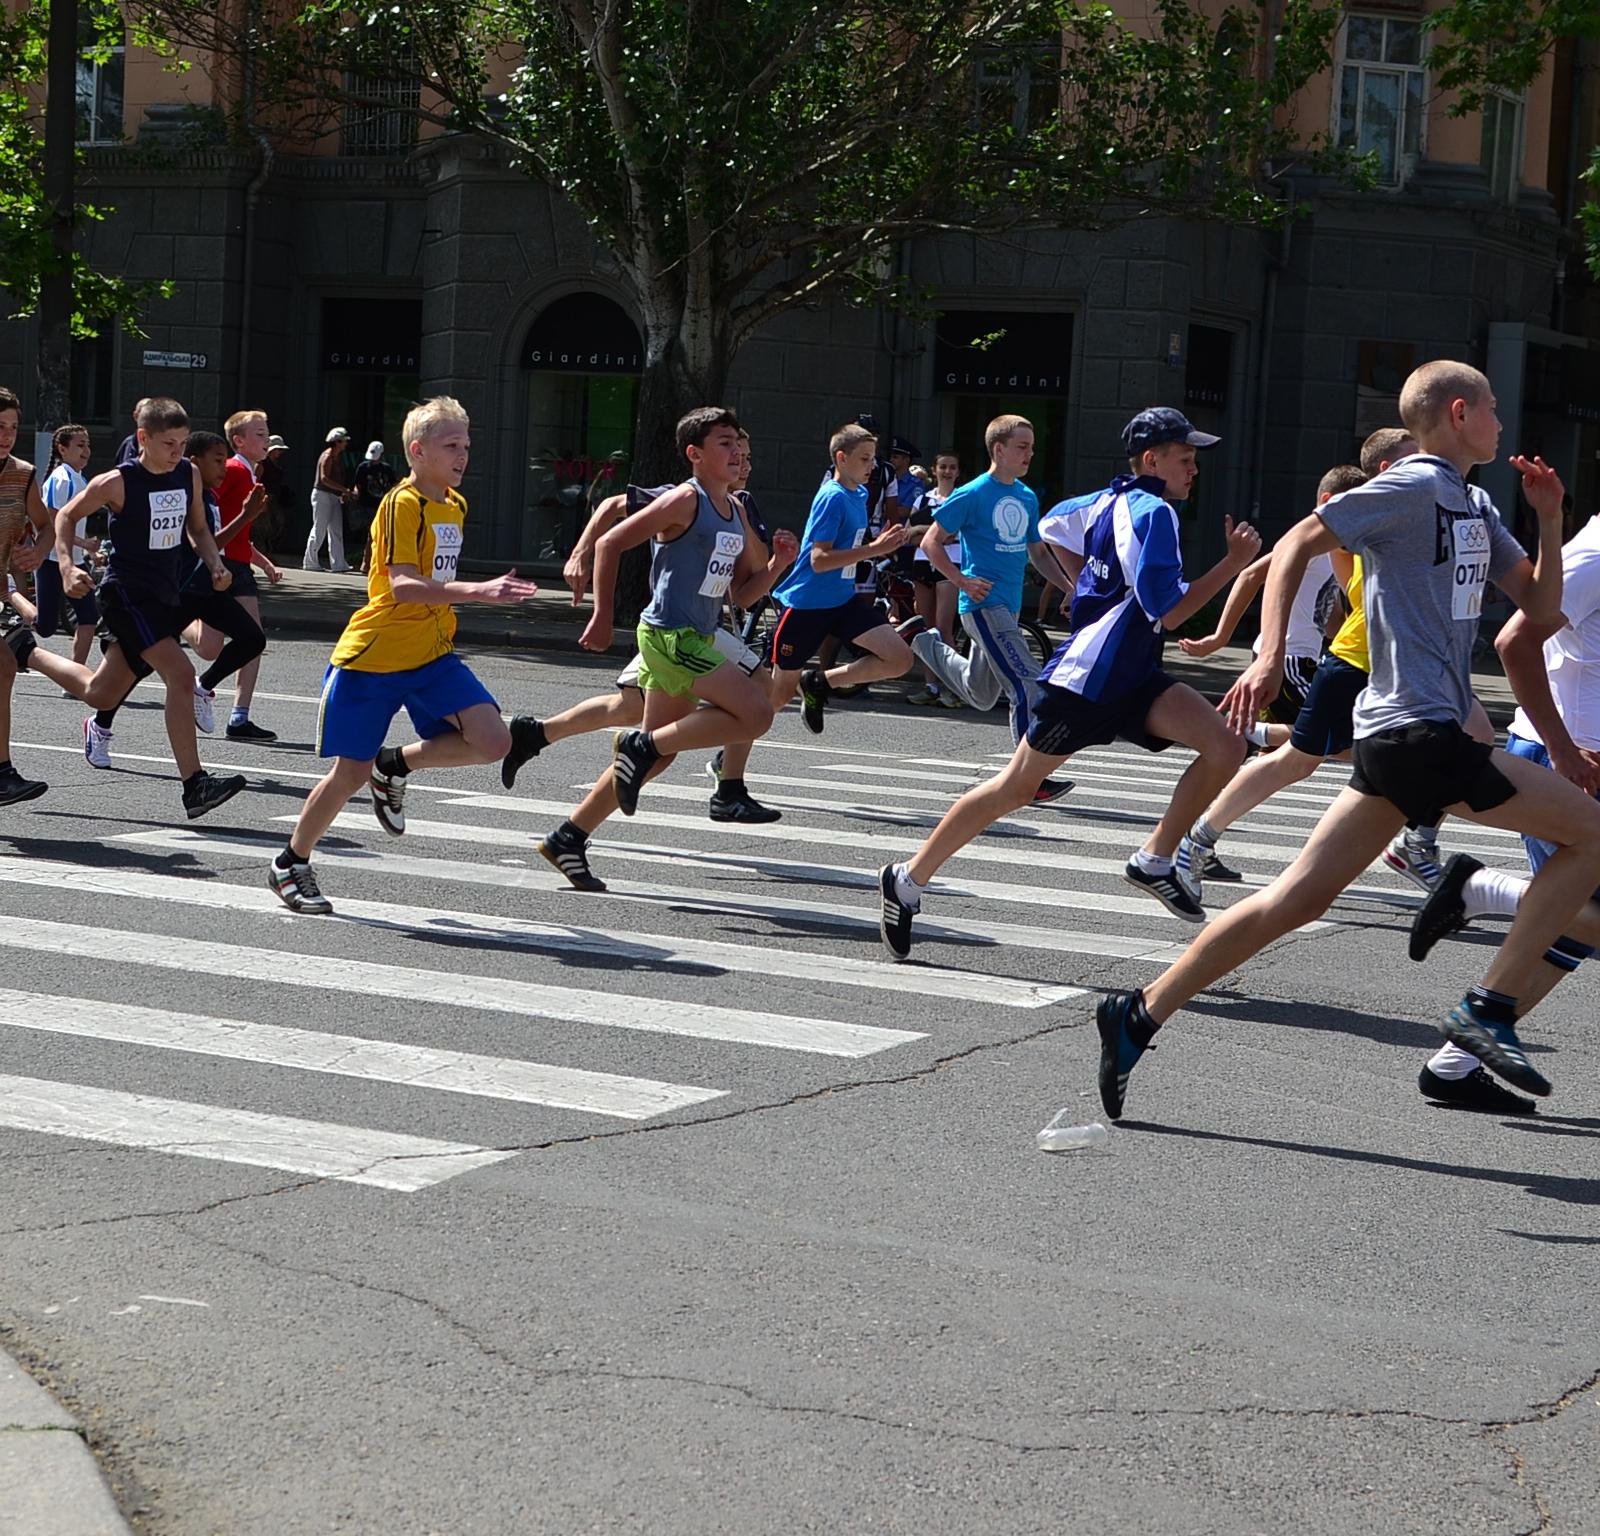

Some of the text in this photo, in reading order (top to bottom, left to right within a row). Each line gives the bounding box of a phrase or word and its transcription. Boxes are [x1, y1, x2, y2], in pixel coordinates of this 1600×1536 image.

[192, 354, 206, 368] 29
[531, 350, 637, 366] Giardini
[946, 372, 1060, 388] Giardini
[152, 515, 184, 530] 0219
[1004, 641, 1029, 677] adidas
